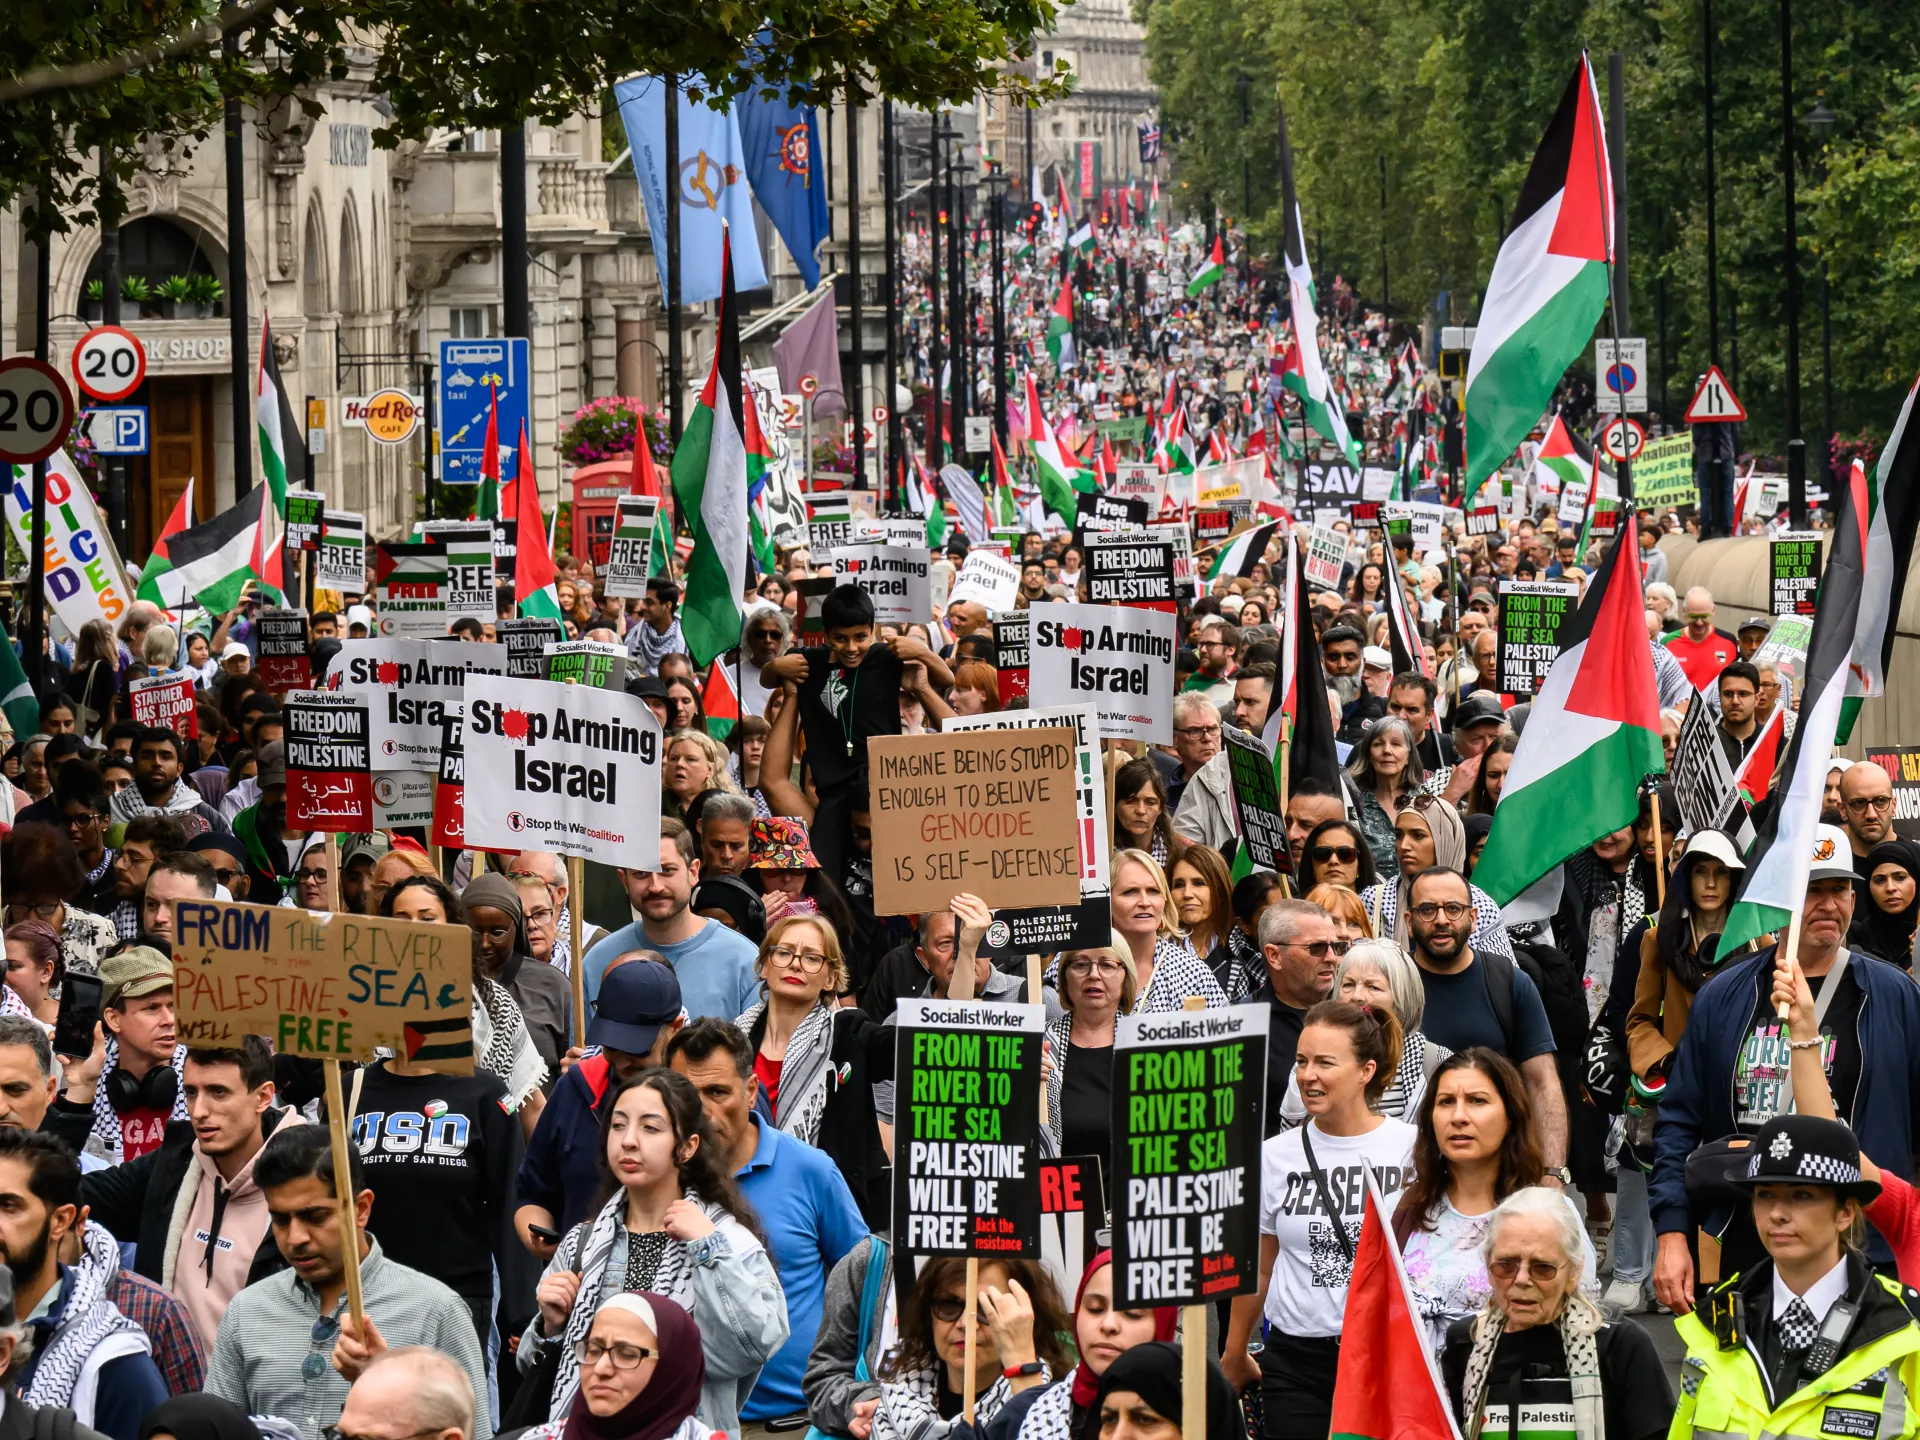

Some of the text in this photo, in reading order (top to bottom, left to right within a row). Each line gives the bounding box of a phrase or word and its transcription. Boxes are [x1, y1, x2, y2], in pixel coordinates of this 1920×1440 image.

[169, 339, 227, 360] SHOP
[85, 348, 135, 378] 20
[448, 391, 467, 400] taxi
[0, 390, 59, 433] 20
[345, 402, 389, 420] Hard
[875, 406, 887, 420] D
[118, 416, 138, 445] P
[380, 425, 402, 434] CAFE
[1611, 432, 1639, 448] 20
[1200, 487, 1240, 500] JEWISH
[1095, 498, 1128, 517] Free
[1076, 511, 1144, 533] Palestine
[1199, 511, 1229, 528] FREE
[1467, 512, 1497, 536] NOW
[809, 522, 851, 541] FREE
[887, 528, 922, 542] Arming
[320, 543, 363, 567] FREE
[611, 539, 650, 564] FREE
[1093, 547, 1165, 570] FREEDOM
[1311, 549, 1342, 565] RESIST!
[1313, 540, 1344, 557] EXIST!
[1775, 542, 1815, 555] FROM THE
[319, 562, 363, 577] PALESTINE
[608, 564, 647, 577] PALESTINE
[869, 556, 928, 578] Arming
[969, 557, 1017, 583] Arming
[1775, 554, 1811, 566] RIVER TO
[1123, 569, 1136, 578] for
[1308, 557, 1340, 585] RETURN!
[1775, 566, 1807, 578] THE SEA
[388, 582, 438, 599] FREE
[1091, 577, 1170, 601] PALESTINE
[1774, 578, 1816, 590] PALESTINE
[1507, 596, 1567, 613] FROM THE
[1774, 590, 1806, 602] WILL BE
[379, 602, 446, 612] PALESTINE
[1774, 602, 1795, 614] FREE
[261, 621, 302, 634] FREEDOM
[1506, 612, 1561, 629] RIVER TO
[502, 632, 555, 651] FREEDOM
[1097, 625, 1172, 664] Arming
[1505, 628, 1554, 645] THE SEA
[261, 641, 306, 655] PALESTINE
[551, 655, 614, 673] FROM THE
[1503, 660, 1551, 677] WILL BE
[588, 671, 605, 688] TO
[1070, 657, 1149, 696] Israel
[1503, 676, 1532, 692] FREE
[134, 685, 184, 708] STARMER
[136, 697, 194, 721] HAS BLOOD
[388, 692, 445, 726] Isra
[1109, 712, 1153, 724] War coalition
[290, 709, 361, 734] FREEDOM
[318, 733, 330, 744] for
[552, 708, 657, 765] Arming
[288, 742, 367, 767] PALESTINE
[398, 744, 427, 755] Stop the
[879, 743, 1070, 780] IMAGINE BEING STUPID
[302, 776, 354, 799] الحرية
[514, 749, 617, 805] Israel
[878, 777, 1051, 811] ENOUGH TO BELIVE
[297, 799, 363, 820] لفلسطين
[526, 818, 625, 843] Stop the War coalition
[920, 810, 1035, 843] GENOCIDE
[1245, 822, 1286, 853] WILL BE
[1249, 841, 1276, 867] FREE
[894, 856, 915, 882] IS
[1013, 914, 1072, 927] PALESTINE
[1013, 922, 1079, 936] SOLIDARITY
[176, 903, 444, 972] FROM THE RIVER
[991, 929, 1006, 940] PSC
[1014, 932, 1071, 945] CAMPAIGN
[175, 967, 338, 1012] PALESTINE
[348, 964, 430, 1011] SEA
[920, 1006, 1024, 1028] Socialist Worker
[177, 1013, 353, 1053] WILL FREE
[1136, 1016, 1244, 1042] Socialist Worker
[912, 1033, 1024, 1070] FROM THE
[1129, 1043, 1244, 1092] FROM THE
[912, 1069, 1011, 1105] RIVER TO
[1129, 1087, 1234, 1134] RIVER TO
[911, 1105, 1001, 1141] THE SEA
[353, 1111, 471, 1157] USD
[395, 1154, 468, 1168] OF SAN DIEGO
[909, 1141, 1025, 1179] PALESTINE
[1128, 1130, 1227, 1176] THE SEA
[908, 1178, 998, 1214] WILL BE
[1127, 1166, 1245, 1218] PALESTINE
[907, 1215, 967, 1250] FREE
[975, 1217, 1014, 1234] Back the
[1126, 1212, 1224, 1259] WILL BE
[975, 1235, 1022, 1252] resistance
[1202, 1254, 1235, 1273] Back the
[1126, 1257, 1194, 1301] FREE
[1202, 1273, 1240, 1296] resistance
[1841, 1411, 1875, 1421] METROPOLITAN
[1843, 1417, 1869, 1427] POLICE
[1822, 1422, 1875, 1438] POLICE OFFICER
